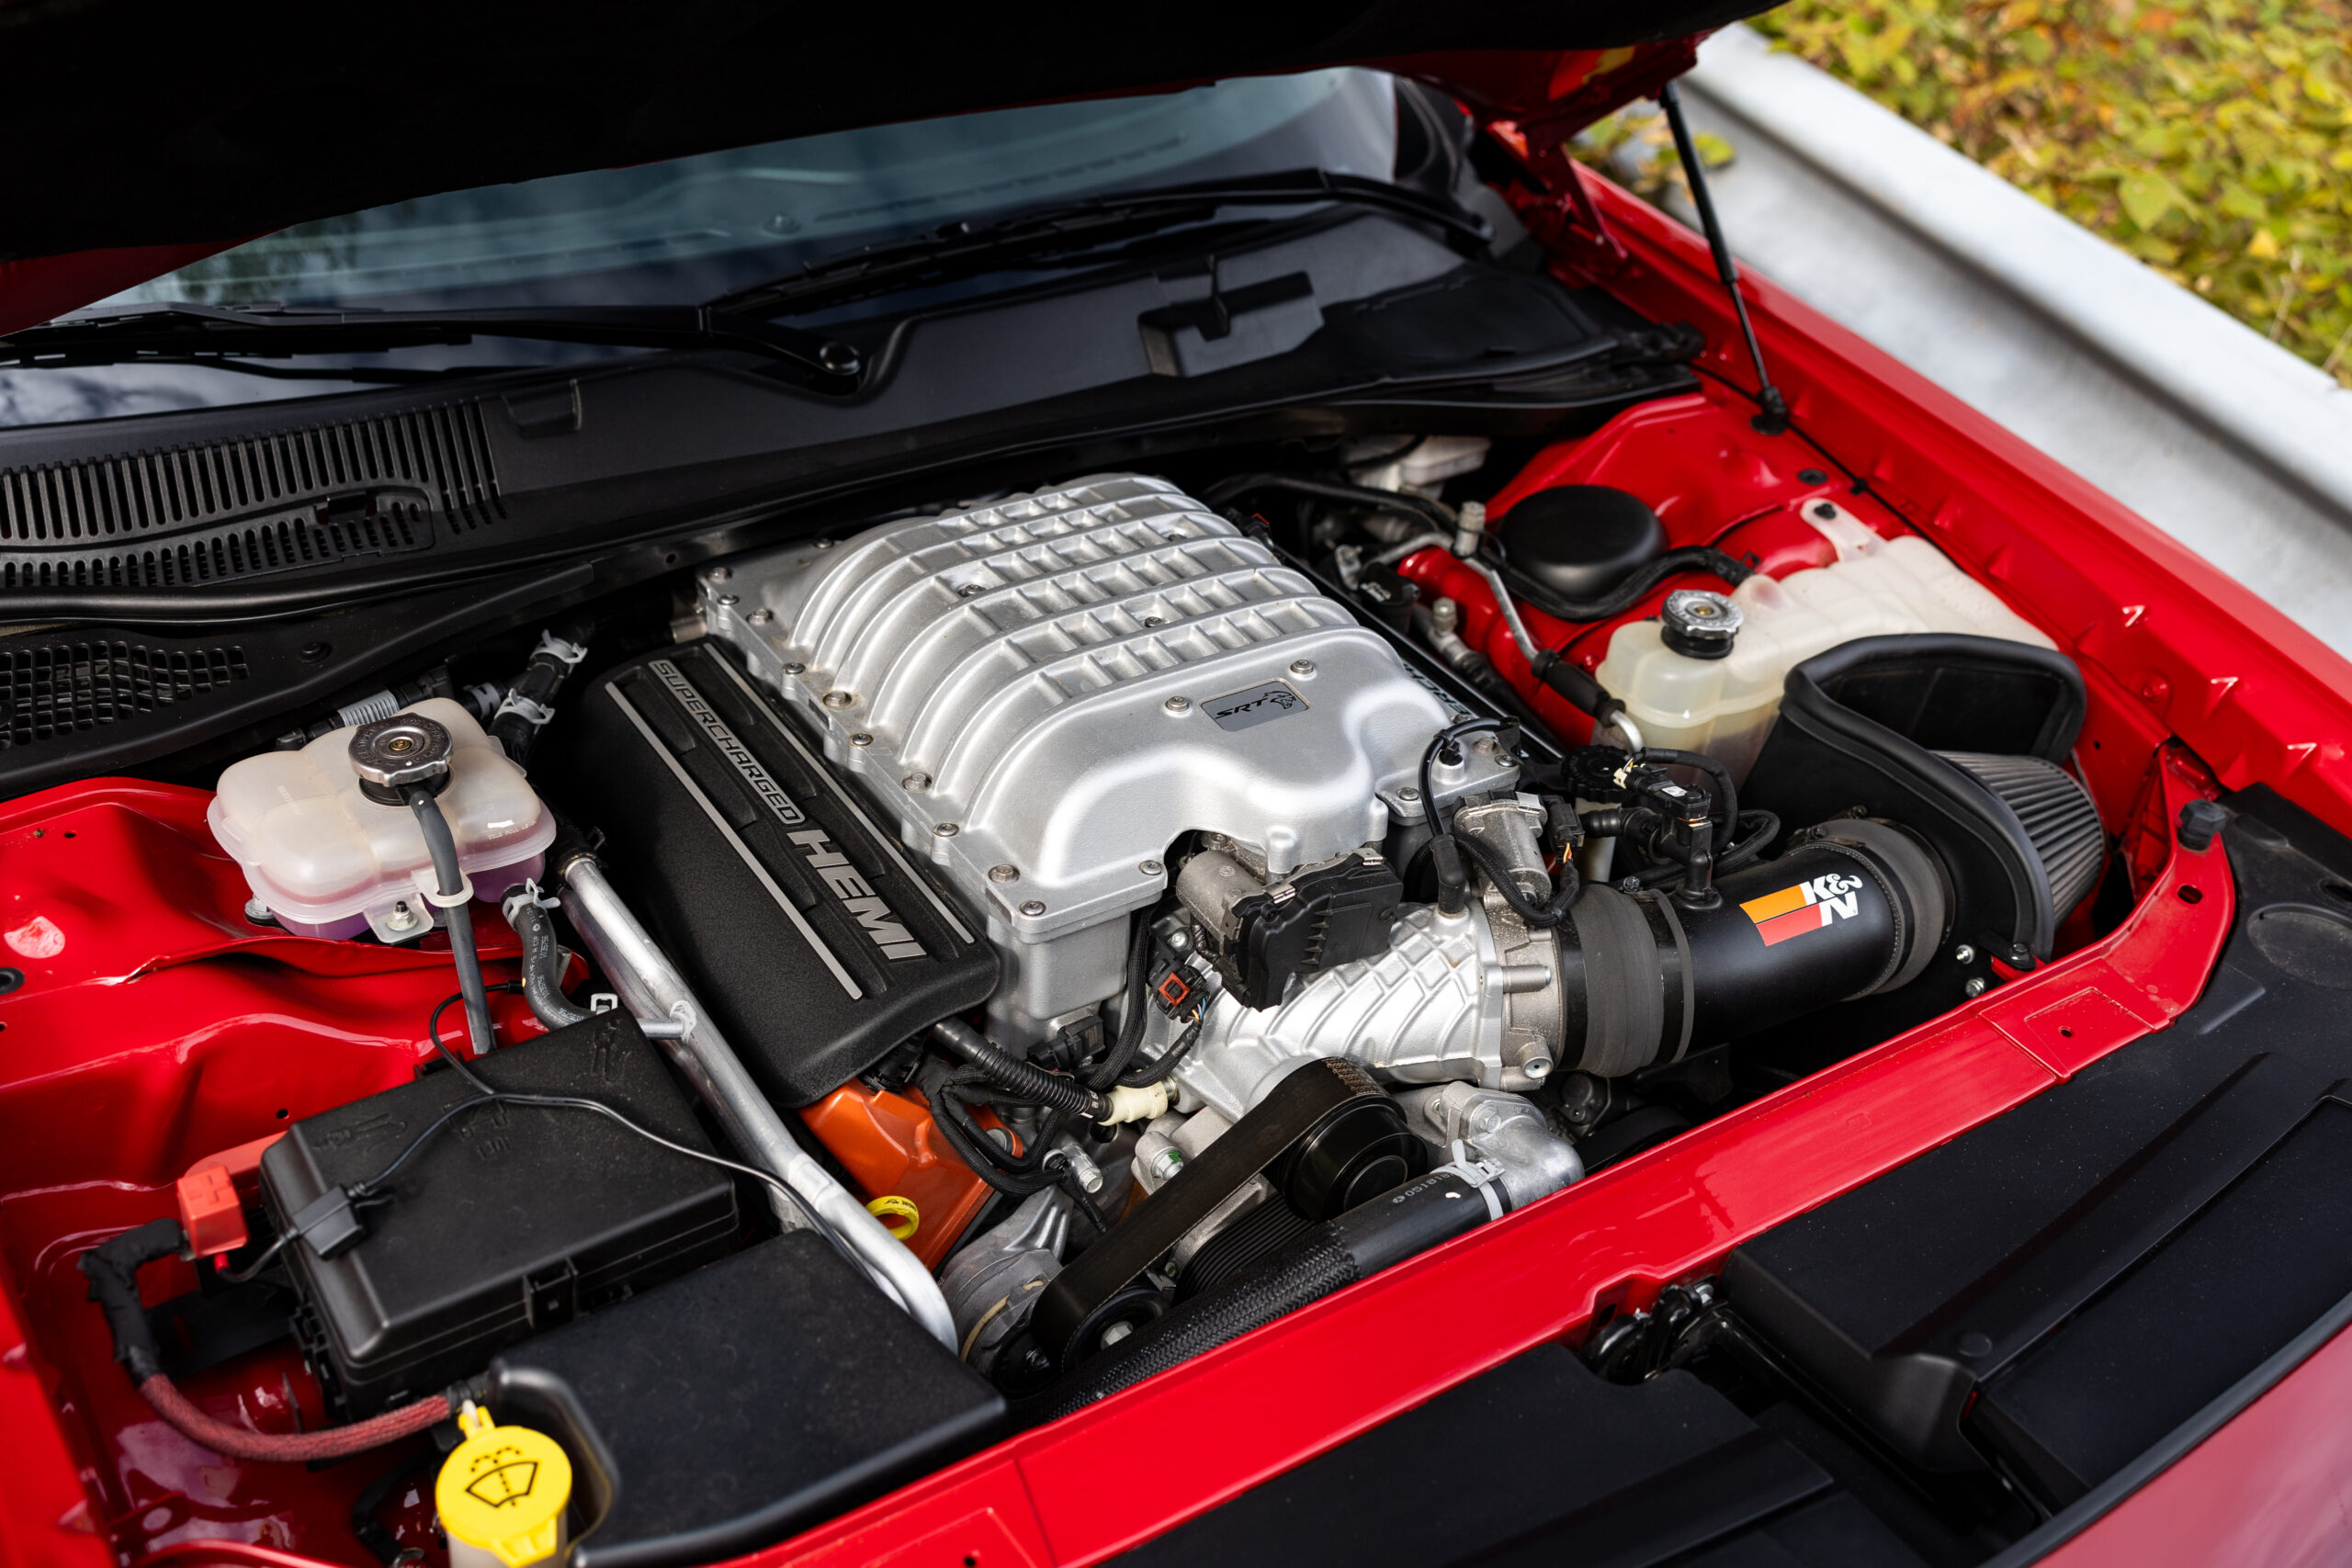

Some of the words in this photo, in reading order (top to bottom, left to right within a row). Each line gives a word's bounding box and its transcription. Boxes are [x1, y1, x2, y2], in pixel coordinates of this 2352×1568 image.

[1215, 698, 1268, 719] SRT
[651, 661, 803, 822] SUPERCHARGED
[787, 829, 927, 960] HEMI
